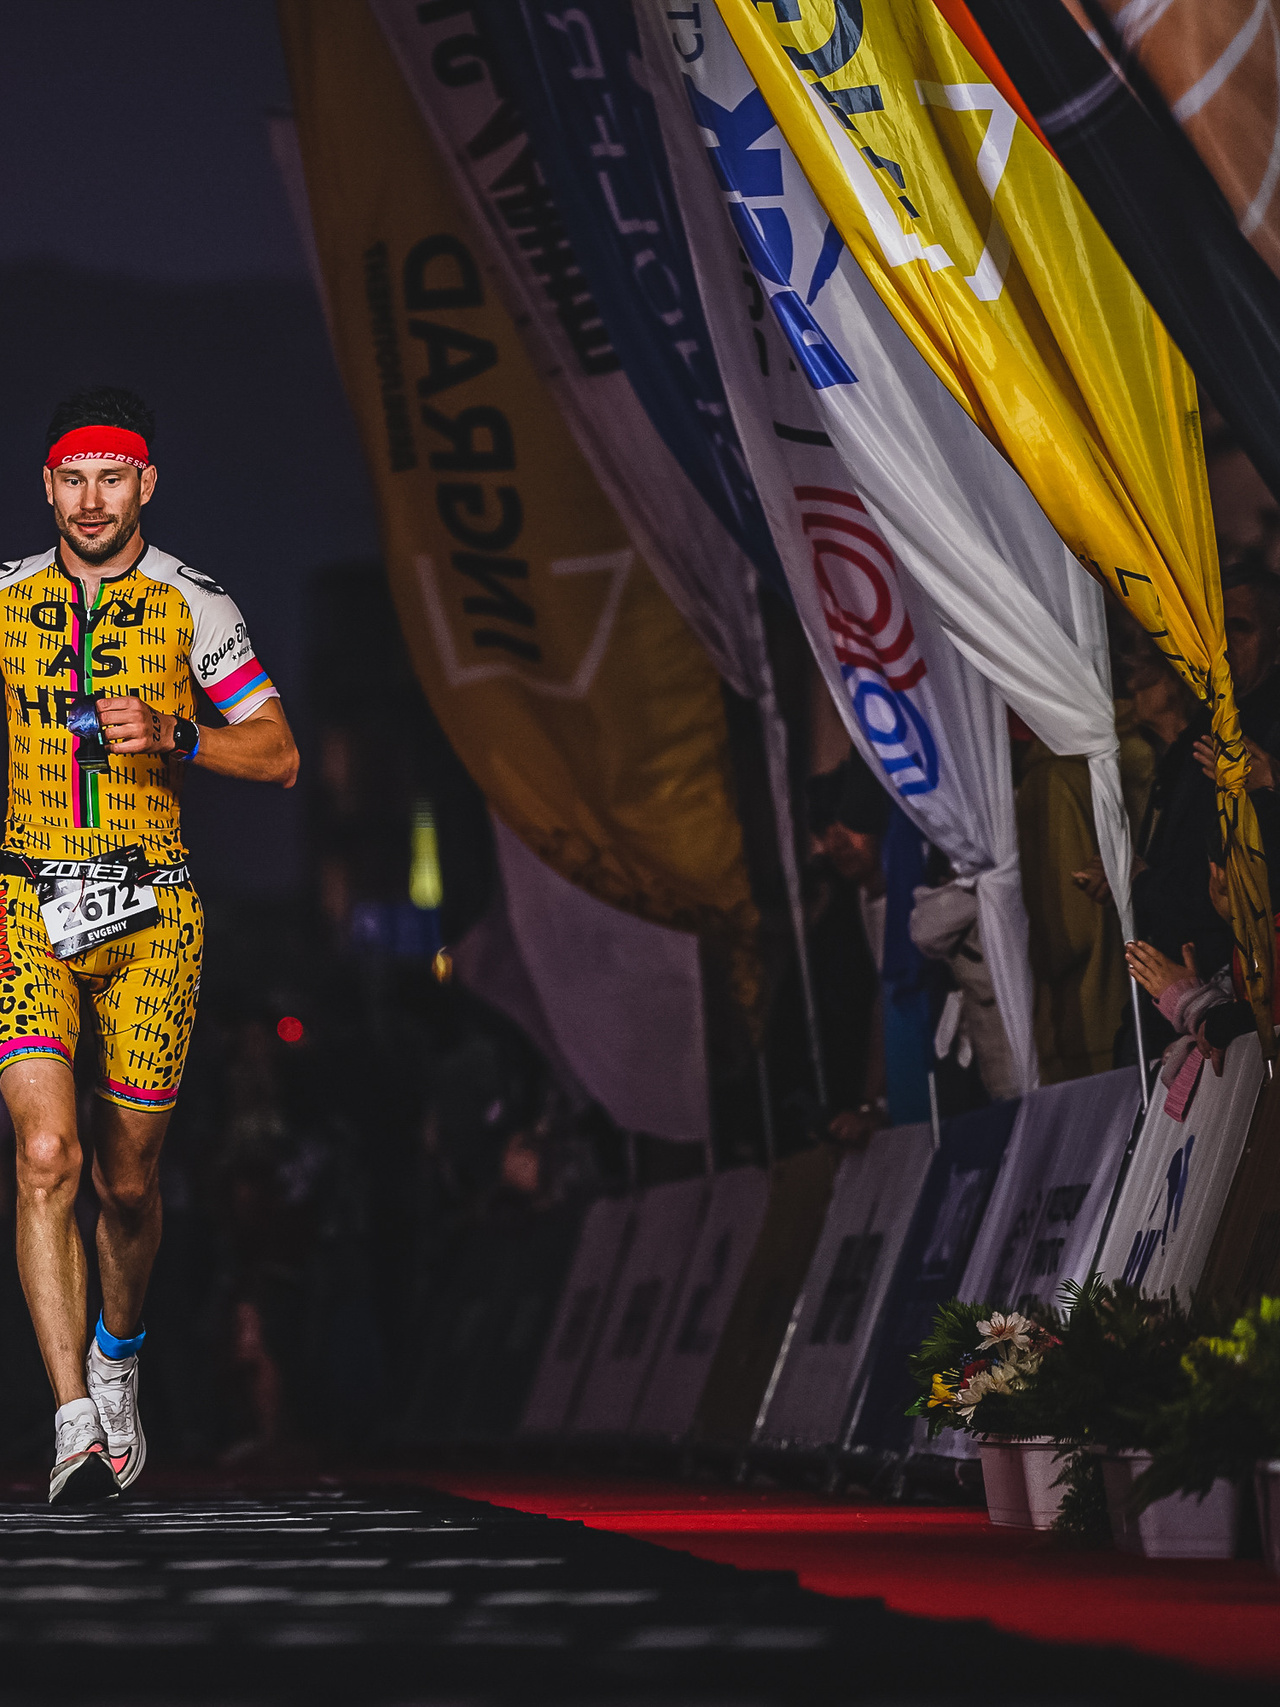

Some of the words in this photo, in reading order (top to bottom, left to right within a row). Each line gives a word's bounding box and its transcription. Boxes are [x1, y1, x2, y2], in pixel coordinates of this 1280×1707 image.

[44, 640, 122, 678] AS
[197, 637, 236, 681] Love
[39, 860, 129, 881] ZONE3
[56, 883, 141, 932] 2672
[87, 920, 128, 942] EVGENIY
